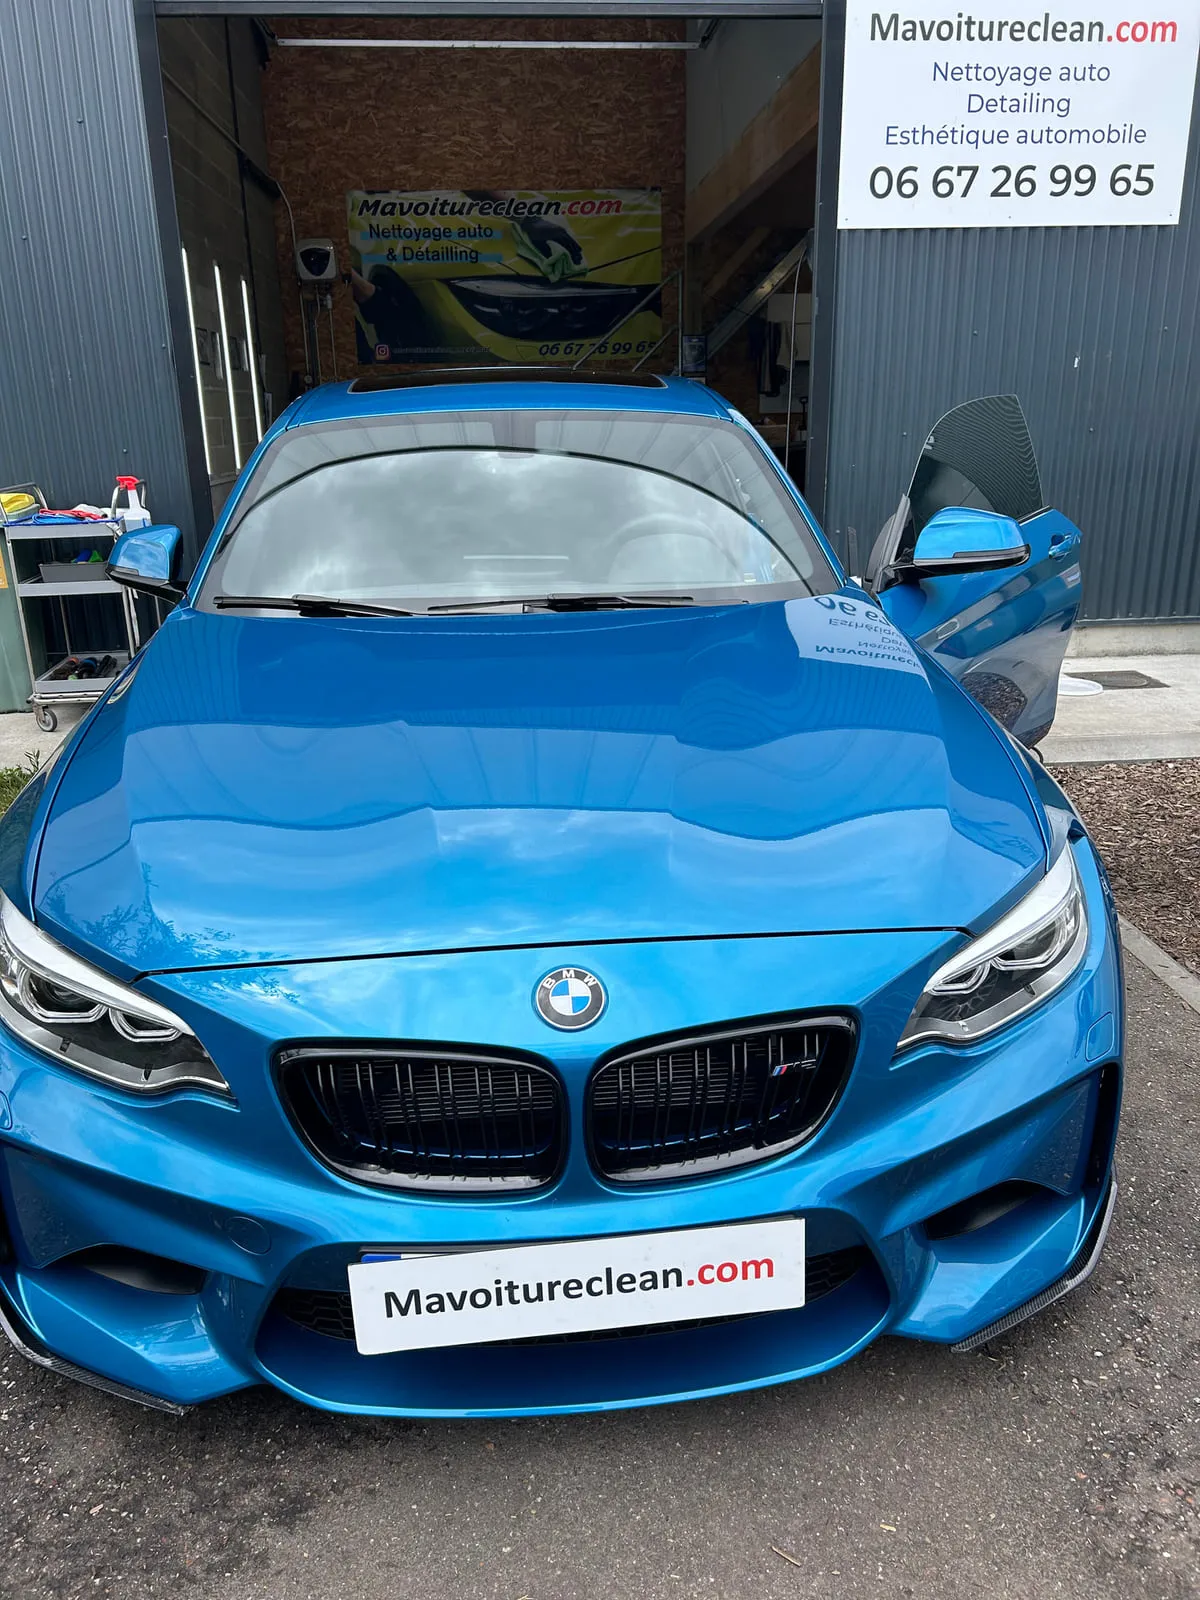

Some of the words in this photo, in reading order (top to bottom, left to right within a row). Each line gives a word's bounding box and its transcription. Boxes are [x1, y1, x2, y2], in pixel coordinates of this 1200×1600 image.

[869, 12, 1178, 43] Mavoitureclean.com
[932, 61, 1052, 87] Nettoyage
[1059, 63, 1111, 82] auto
[967, 92, 1072, 118] Detailing
[885, 124, 1010, 149] Esthétique
[1016, 124, 1148, 145] automobile
[869, 166, 919, 199] 06
[932, 165, 980, 198] 67
[990, 165, 1037, 198] 26
[1049, 164, 1097, 197] 99
[1109, 164, 1156, 197] 65
[357, 197, 623, 218] Mavoitureclean.com
[368, 223, 453, 242] Nettoyage
[457, 225, 494, 239] auto
[386, 248, 398, 262] &
[402, 246, 480, 264] Détailling
[538, 342, 561, 356] 06
[563, 342, 585, 356] 67
[611, 342, 633, 355] 99
[542, 969, 597, 989] BMW
[383, 1255, 775, 1319] Mavoitureclean.com
